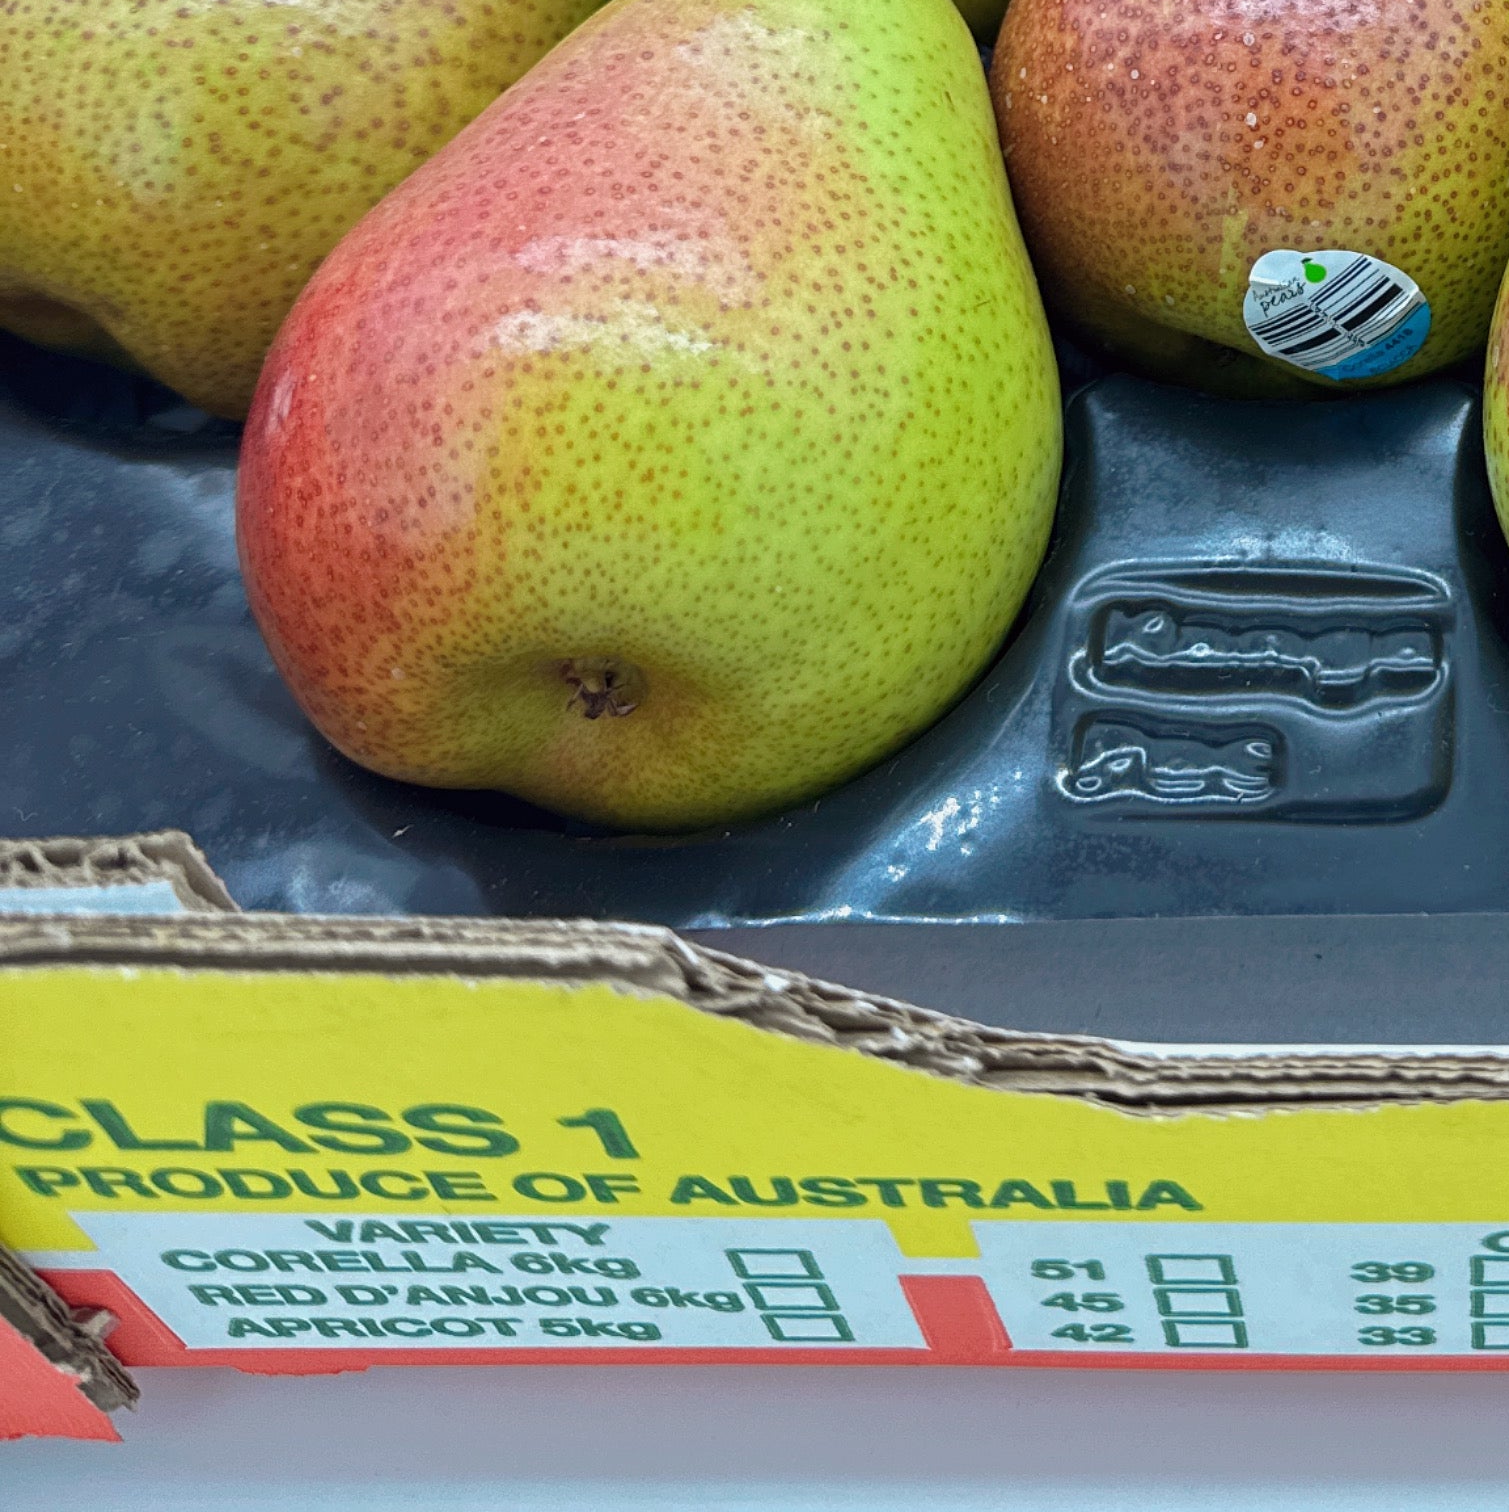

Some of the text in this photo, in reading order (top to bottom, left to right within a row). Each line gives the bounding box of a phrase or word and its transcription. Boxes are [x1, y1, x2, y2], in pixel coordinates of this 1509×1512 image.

[1260, 282, 1307, 317] pears
[0, 1098, 641, 1159] CLASS 1
[14, 1165, 1203, 1211] PRODUCE OF AUSTRALIA
[303, 1219, 611, 1247] VARIETY
[159, 1249, 644, 1279] CORELLA 6kg
[1030, 1259, 1105, 1281] 51
[1349, 1261, 1436, 1282] 39
[188, 1284, 747, 1313] RED D'ANJOU 6kg
[1041, 1293, 1124, 1312] 45
[1355, 1294, 1437, 1315] 35
[226, 1317, 662, 1340] APRICOT 5kg
[1050, 1324, 1134, 1343] 42
[1358, 1326, 1437, 1345] 33
